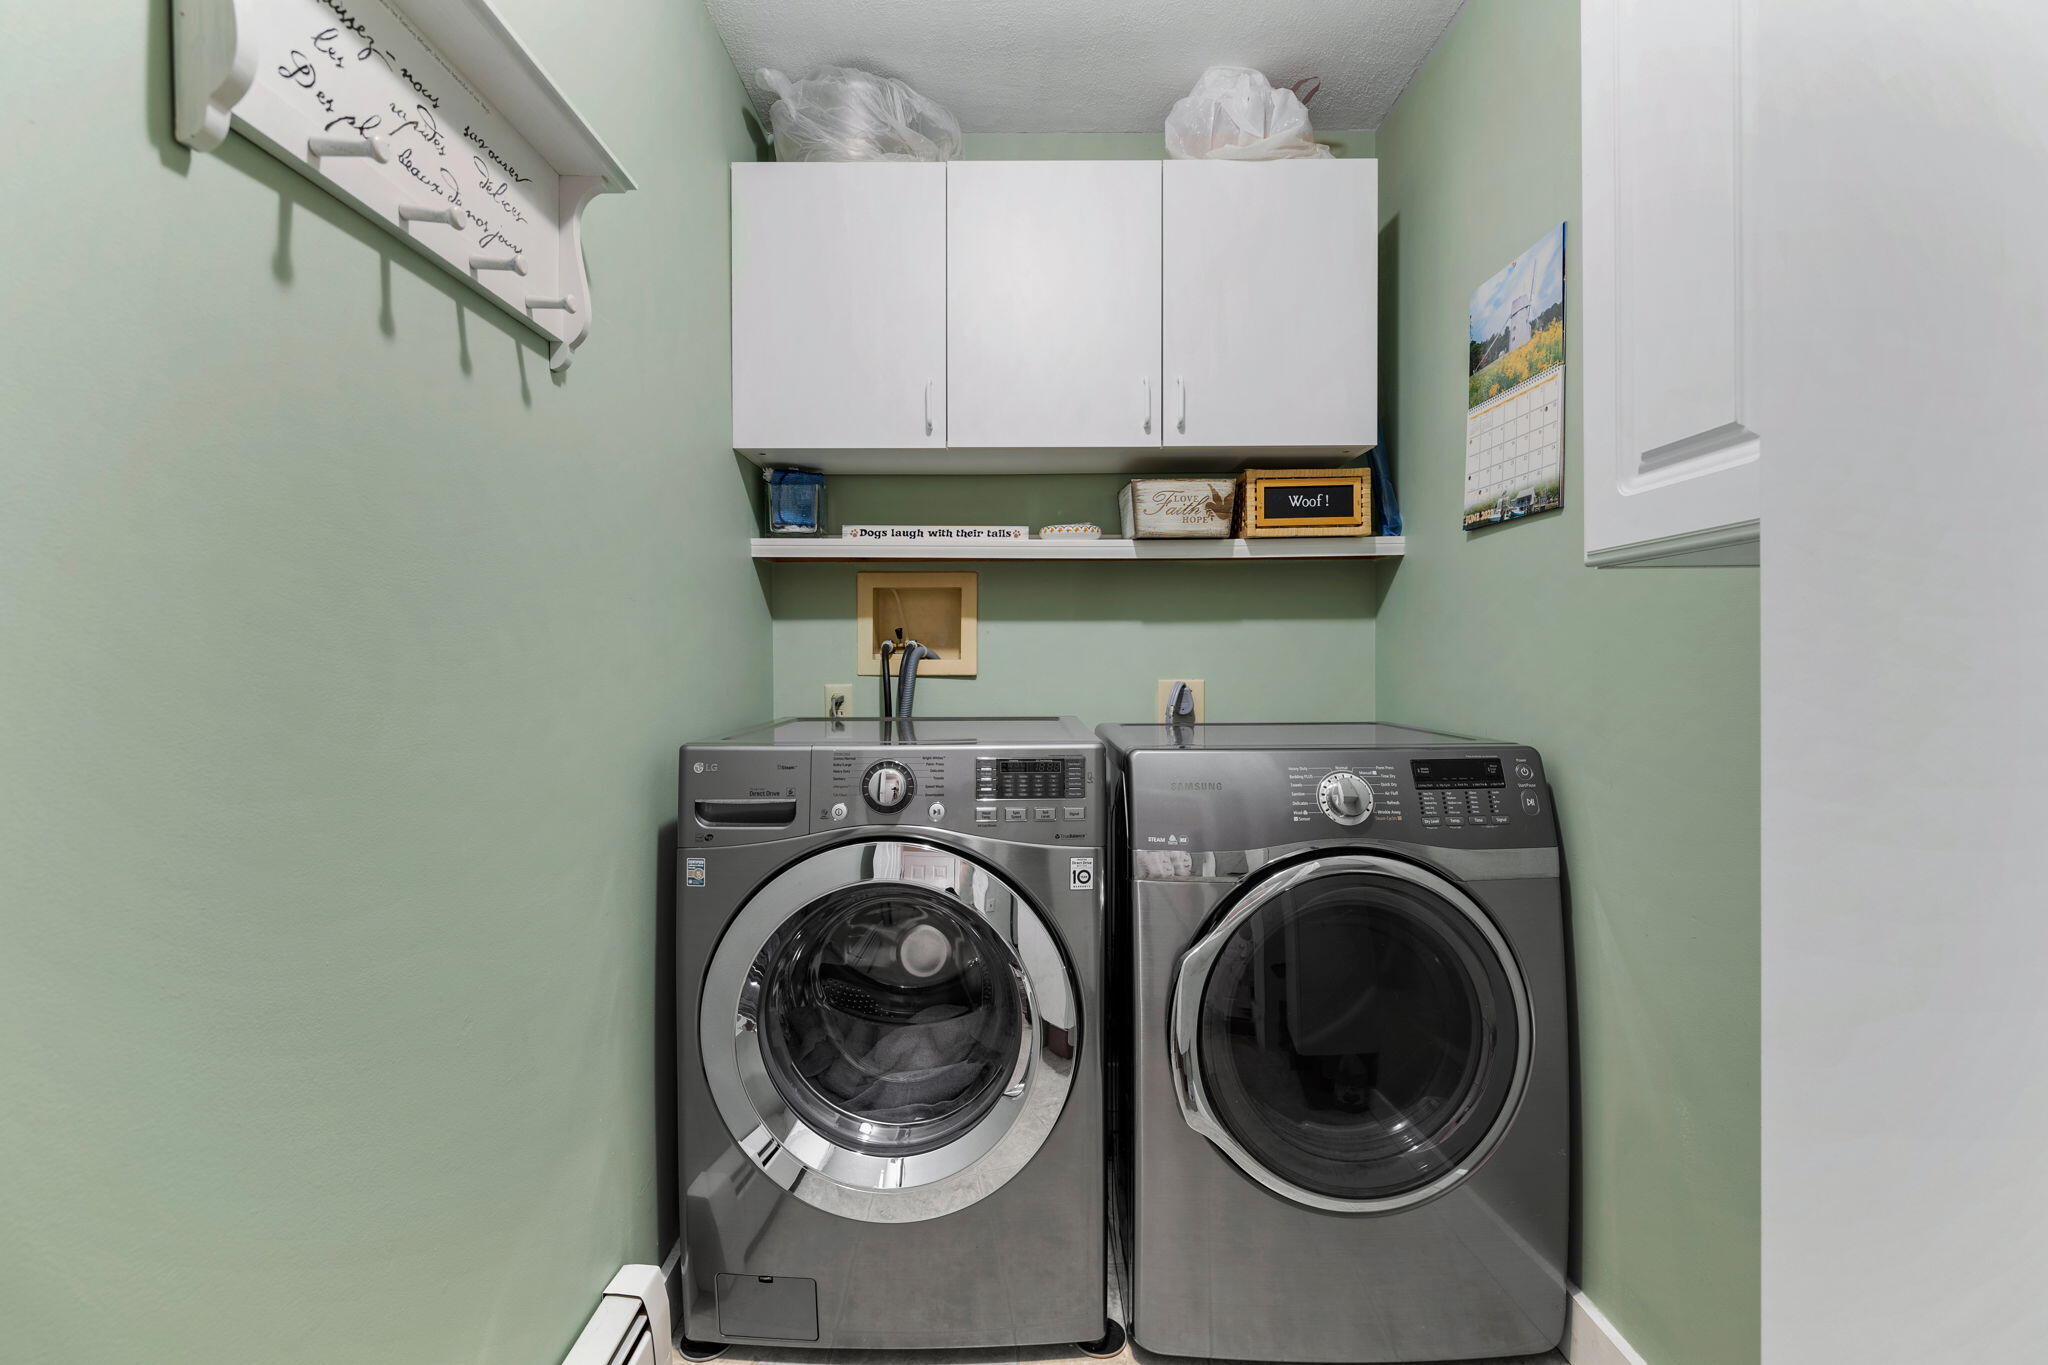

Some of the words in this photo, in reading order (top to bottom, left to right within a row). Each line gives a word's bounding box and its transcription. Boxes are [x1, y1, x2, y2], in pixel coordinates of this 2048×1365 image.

[311, 28, 344, 68] les
[388, 102, 446, 155] rapides
[398, 148, 443, 195] beaux
[466, 210, 489, 232] nos
[1143, 490, 1210, 516] Faith
[1173, 494, 1199, 503] LOVE
[1182, 516, 1209, 524] HOPE
[859, 528, 888, 539] Dogs
[891, 528, 924, 540] laugh
[928, 529, 953, 538] with
[956, 529, 984, 538] their
[987, 529, 1012, 538] tails
[1170, 782, 1223, 791] SAMSUNG
[1073, 870, 1091, 884] 10
